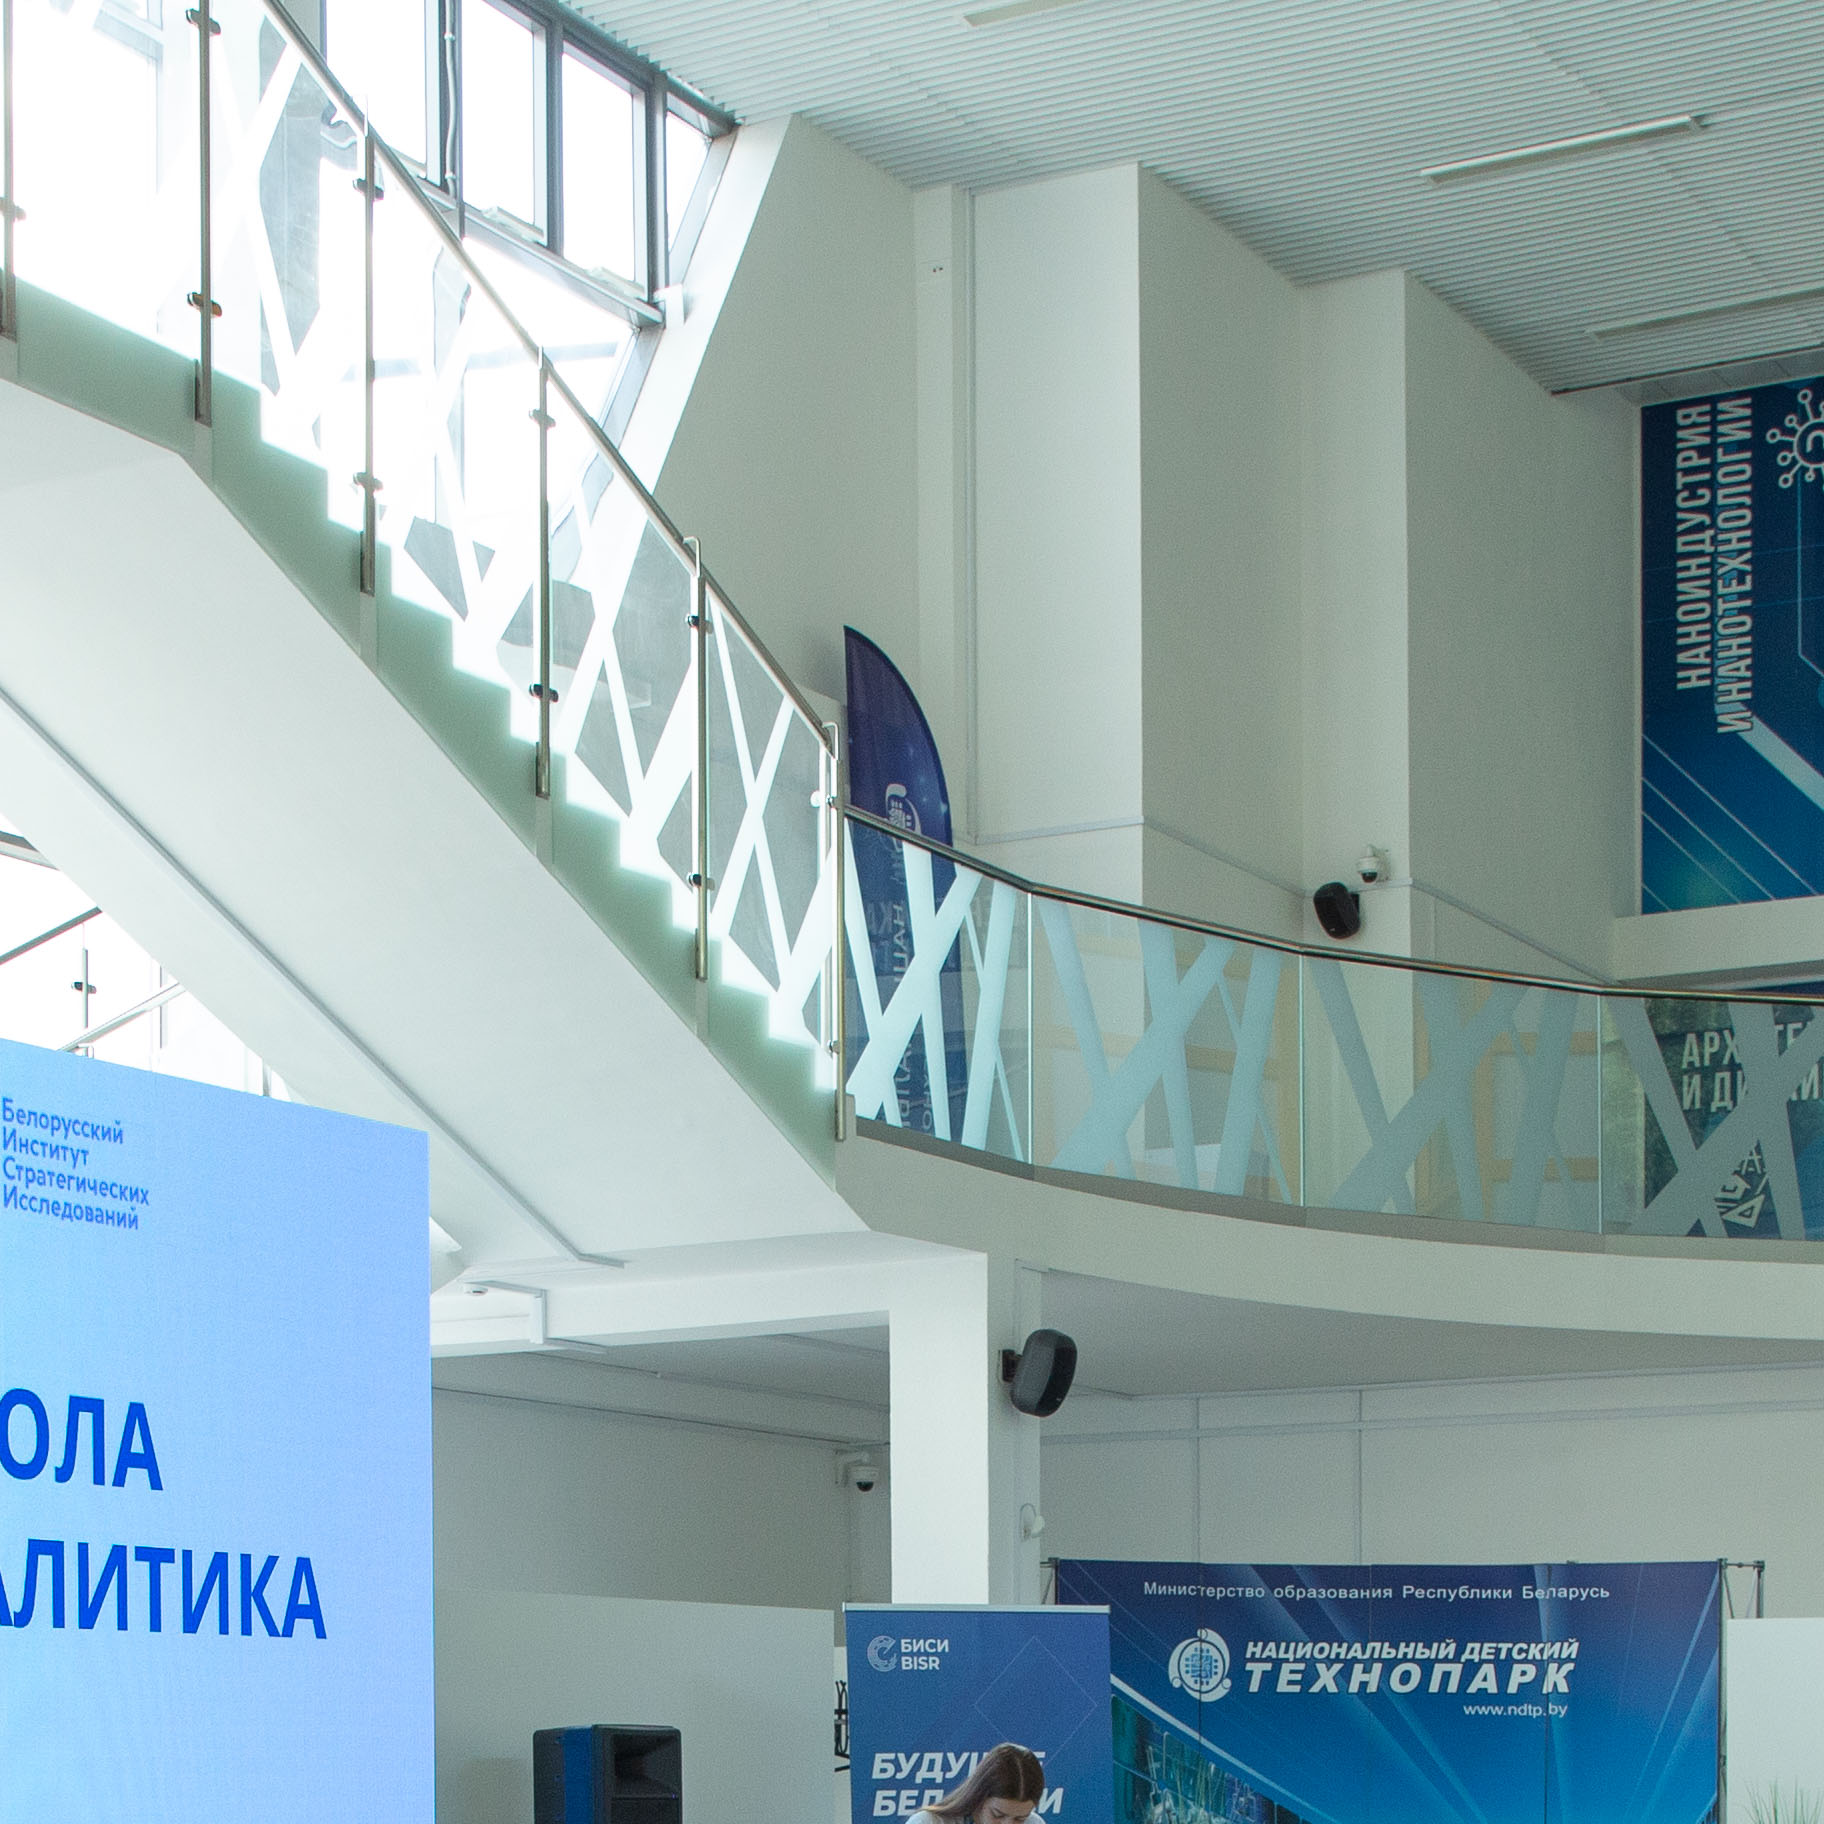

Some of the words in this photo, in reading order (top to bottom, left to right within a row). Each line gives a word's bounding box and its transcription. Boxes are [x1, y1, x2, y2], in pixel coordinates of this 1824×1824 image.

[1676, 404, 1712, 691] НАНОИНДУСТРИЯ
[1717, 397, 1753, 703] НАНОТЕХНОЛОГИИ
[2, 1096, 124, 1146] Белорусский
[2, 1128, 89, 1167] Институт
[2, 1158, 150, 1206] Стратегических
[2, 1184, 140, 1231] Исследований
[1144, 1580, 1265, 1600] Министерство
[1274, 1583, 1393, 1602] образования
[1402, 1585, 1513, 1603] Республики
[1521, 1584, 1610, 1602] Беларусь
[900, 1638, 950, 1653] БИСИ
[901, 1656, 941, 1670] BISR
[1245, 1638, 1457, 1661] НАЦИОНАЛЬНЫЙ
[1461, 1638, 1580, 1663] ДЕТСКИЙ
[1245, 1662, 1577, 1694] ТЕХНОПАРК
[1462, 1703, 1568, 1719] www.ndtp.by
